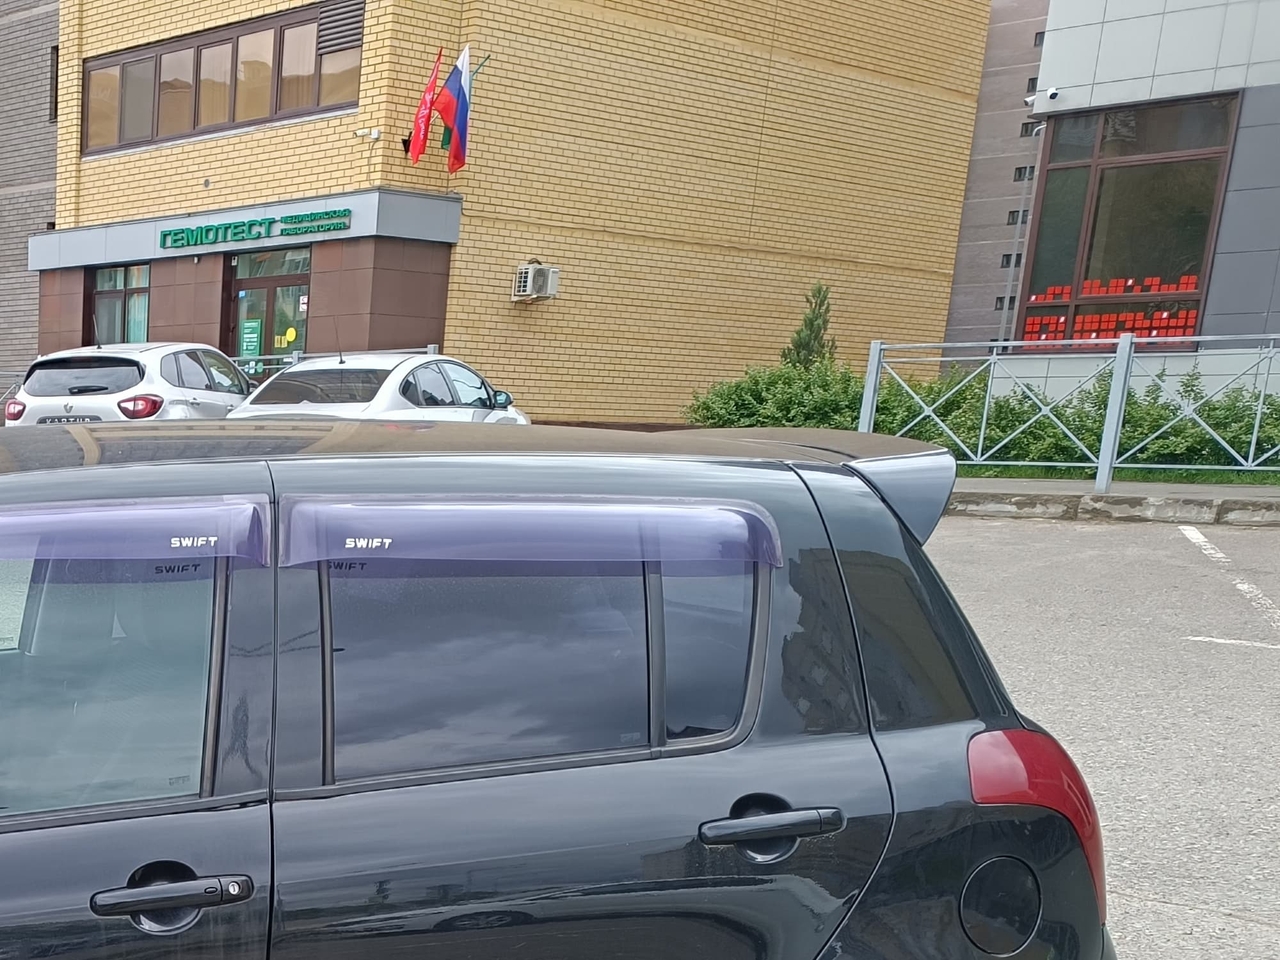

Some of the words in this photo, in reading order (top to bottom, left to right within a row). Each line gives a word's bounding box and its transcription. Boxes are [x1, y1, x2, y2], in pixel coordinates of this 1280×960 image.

[160, 218, 275, 249] ГЕМОТЕСТ
[170, 536, 218, 548] SWIFT
[345, 538, 393, 549] SWIFT
[154, 564, 201, 574] SWIFT
